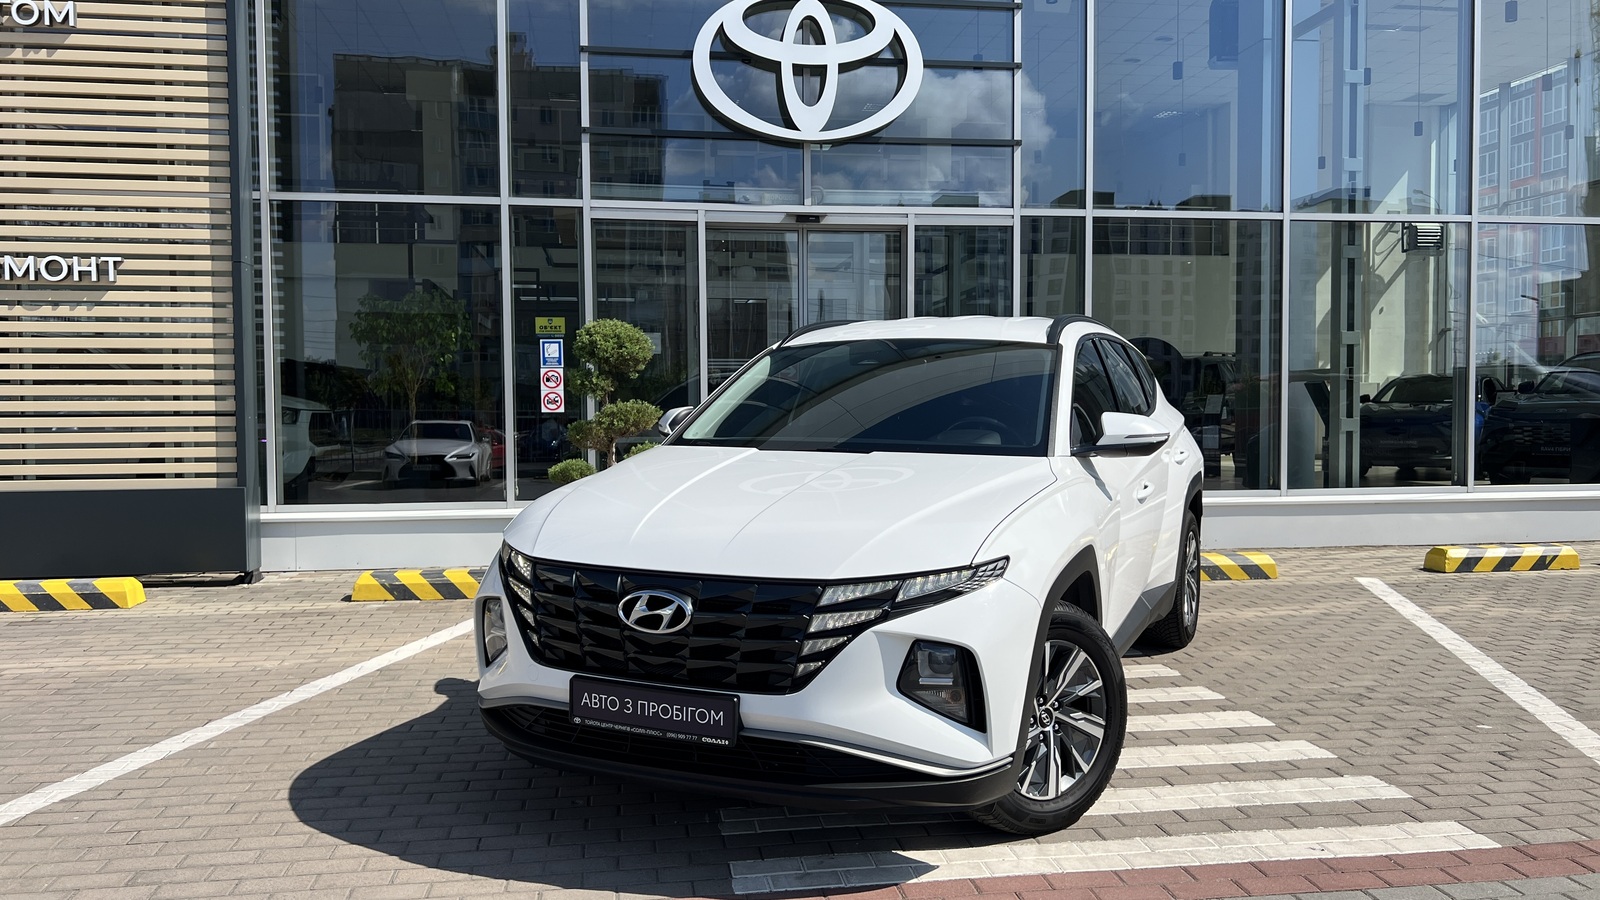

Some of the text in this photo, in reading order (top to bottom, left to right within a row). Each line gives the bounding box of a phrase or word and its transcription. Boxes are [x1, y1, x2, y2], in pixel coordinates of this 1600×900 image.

[0, 0, 76, 27] ОМ
[4, 255, 122, 281] МОНТ
[581, 692, 620, 711] АВТО
[637, 700, 724, 726] ПРОБІГОМ
[584, 719, 600, 727] ТОЙОТА
